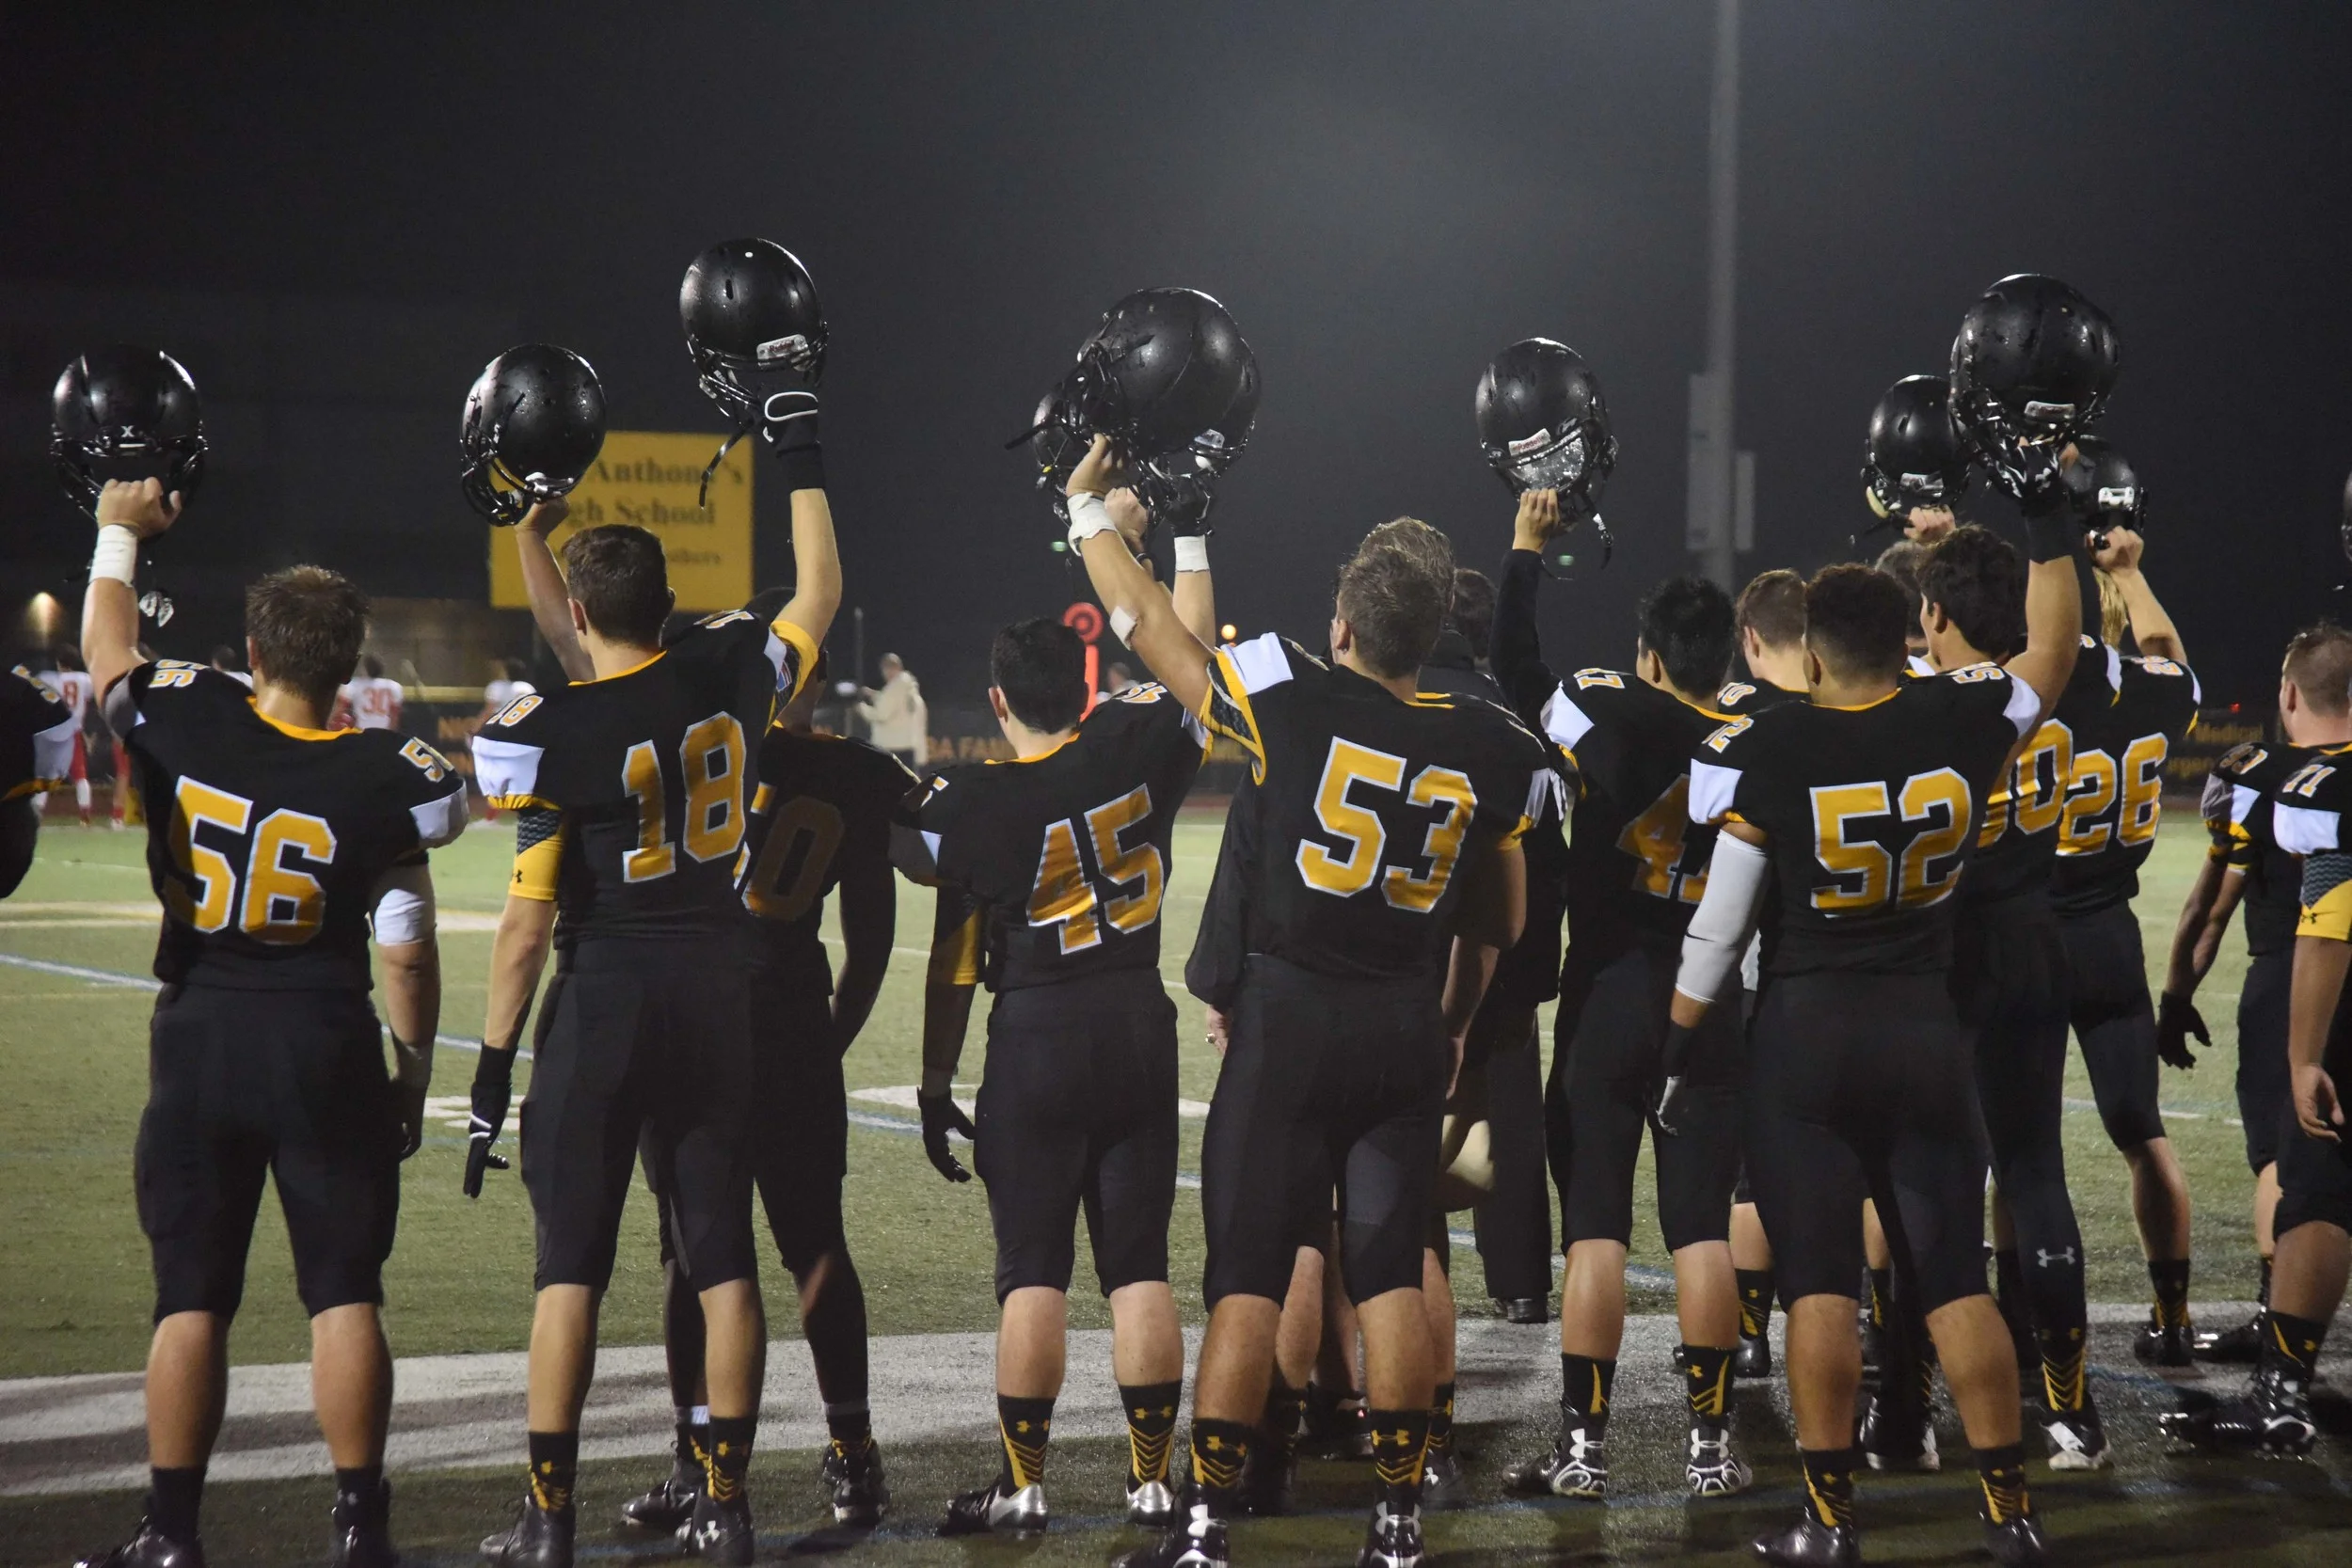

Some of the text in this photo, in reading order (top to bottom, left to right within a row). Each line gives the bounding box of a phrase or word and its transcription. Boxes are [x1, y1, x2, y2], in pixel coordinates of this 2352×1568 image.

[615, 496, 716, 525] School
[399, 736, 454, 783] 5
[622, 711, 746, 884] 18
[1295, 736, 1477, 913] 53
[2056, 725, 2169, 856] 26
[168, 774, 338, 944] 56
[734, 781, 845, 921] 0
[1025, 783, 1164, 955] 45
[1809, 767, 1972, 918] 52
